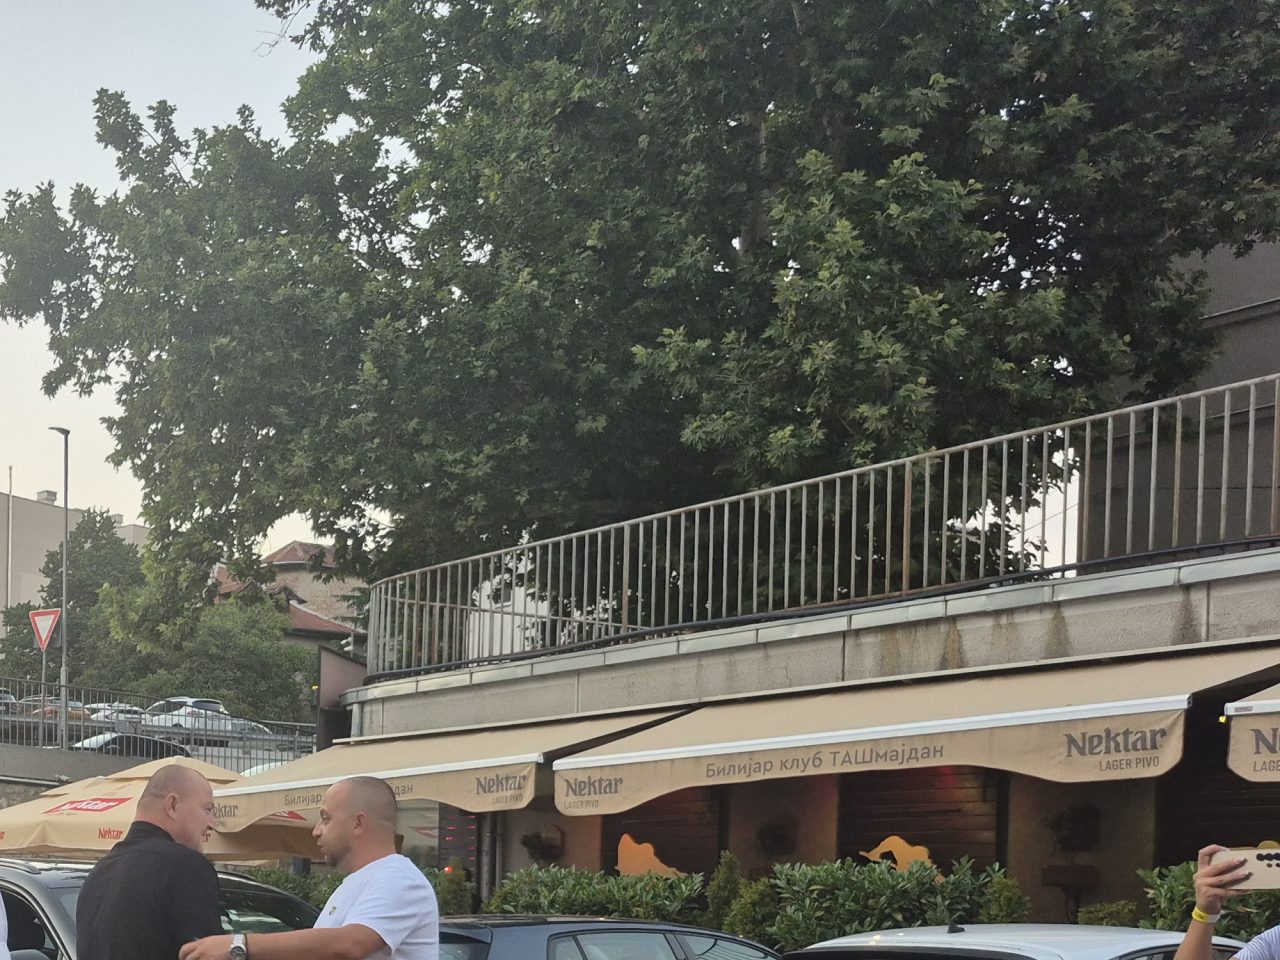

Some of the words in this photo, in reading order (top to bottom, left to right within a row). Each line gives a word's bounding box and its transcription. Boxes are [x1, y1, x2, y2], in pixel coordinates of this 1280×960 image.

[1064, 726, 1167, 758] Nektar
[705, 757, 774, 778] Билијар
[779, 750, 823, 772] клуб
[830, 743, 944, 767] ТАШмајдан
[1099, 758, 1132, 771] LAGER
[1135, 756, 1160, 768] PIVO
[1253, 759, 1280, 772] LAGE
[475, 774, 527, 795] Nektar
[565, 776, 624, 797] Nektar
[284, 794, 323, 806] Билијар
[212, 803, 239, 819] ektar
[98, 828, 123, 840] Nektar
